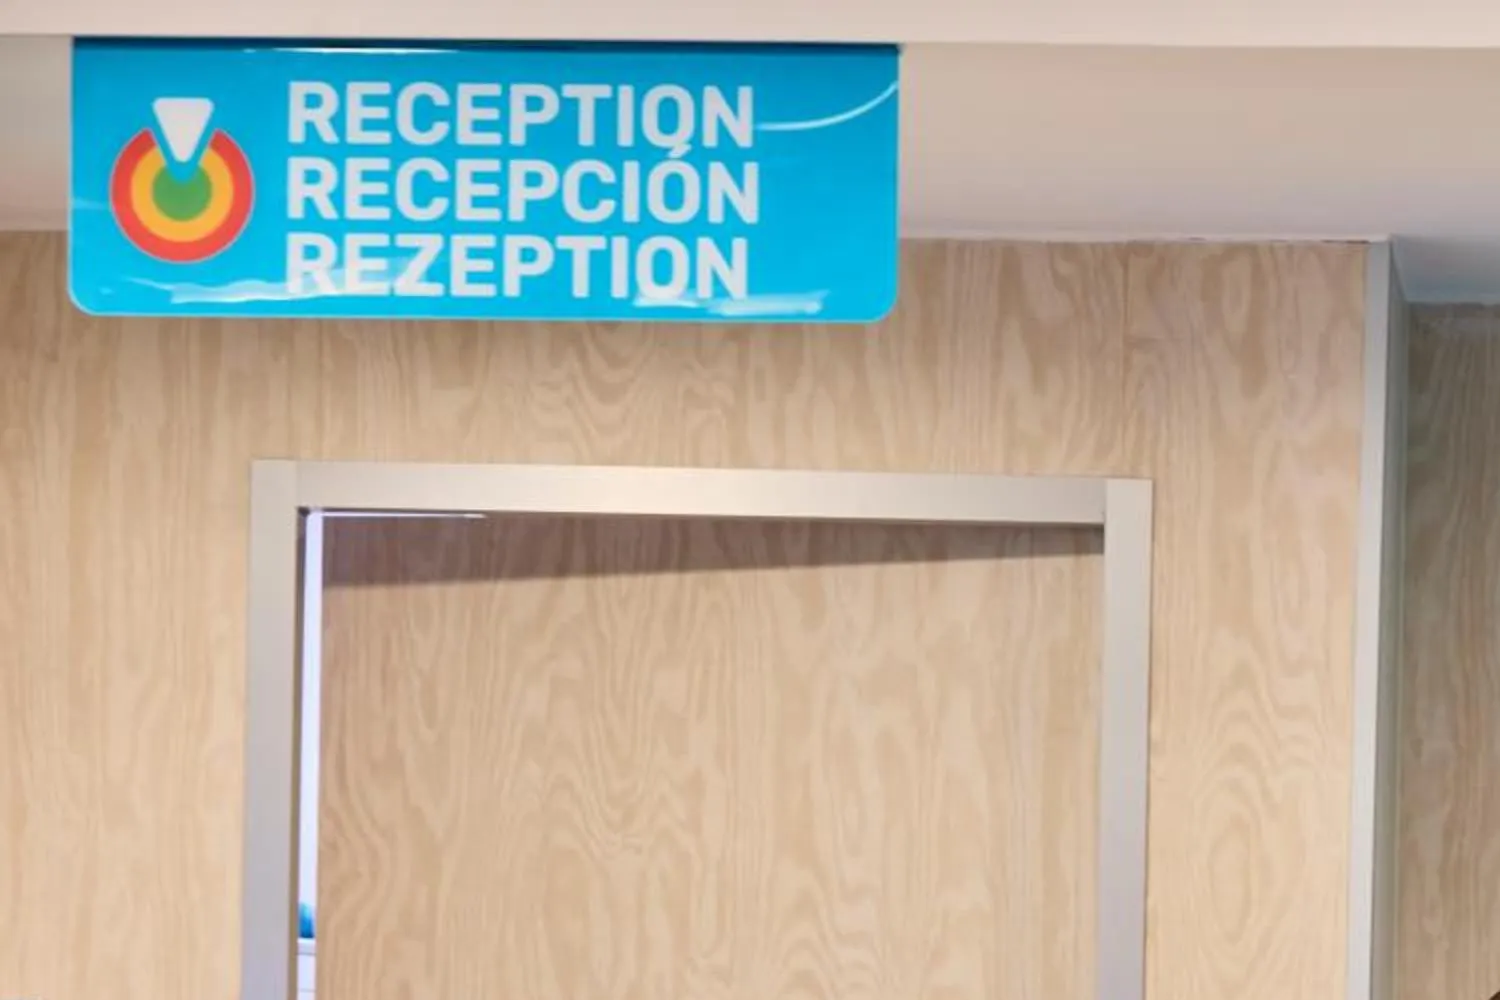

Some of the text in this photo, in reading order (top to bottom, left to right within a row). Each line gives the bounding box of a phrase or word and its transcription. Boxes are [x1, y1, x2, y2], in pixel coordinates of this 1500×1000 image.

[287, 81, 753, 148] RECEPTION
[286, 147, 760, 224] RECEPCIÓN
[285, 233, 748, 300] REZEPTION
